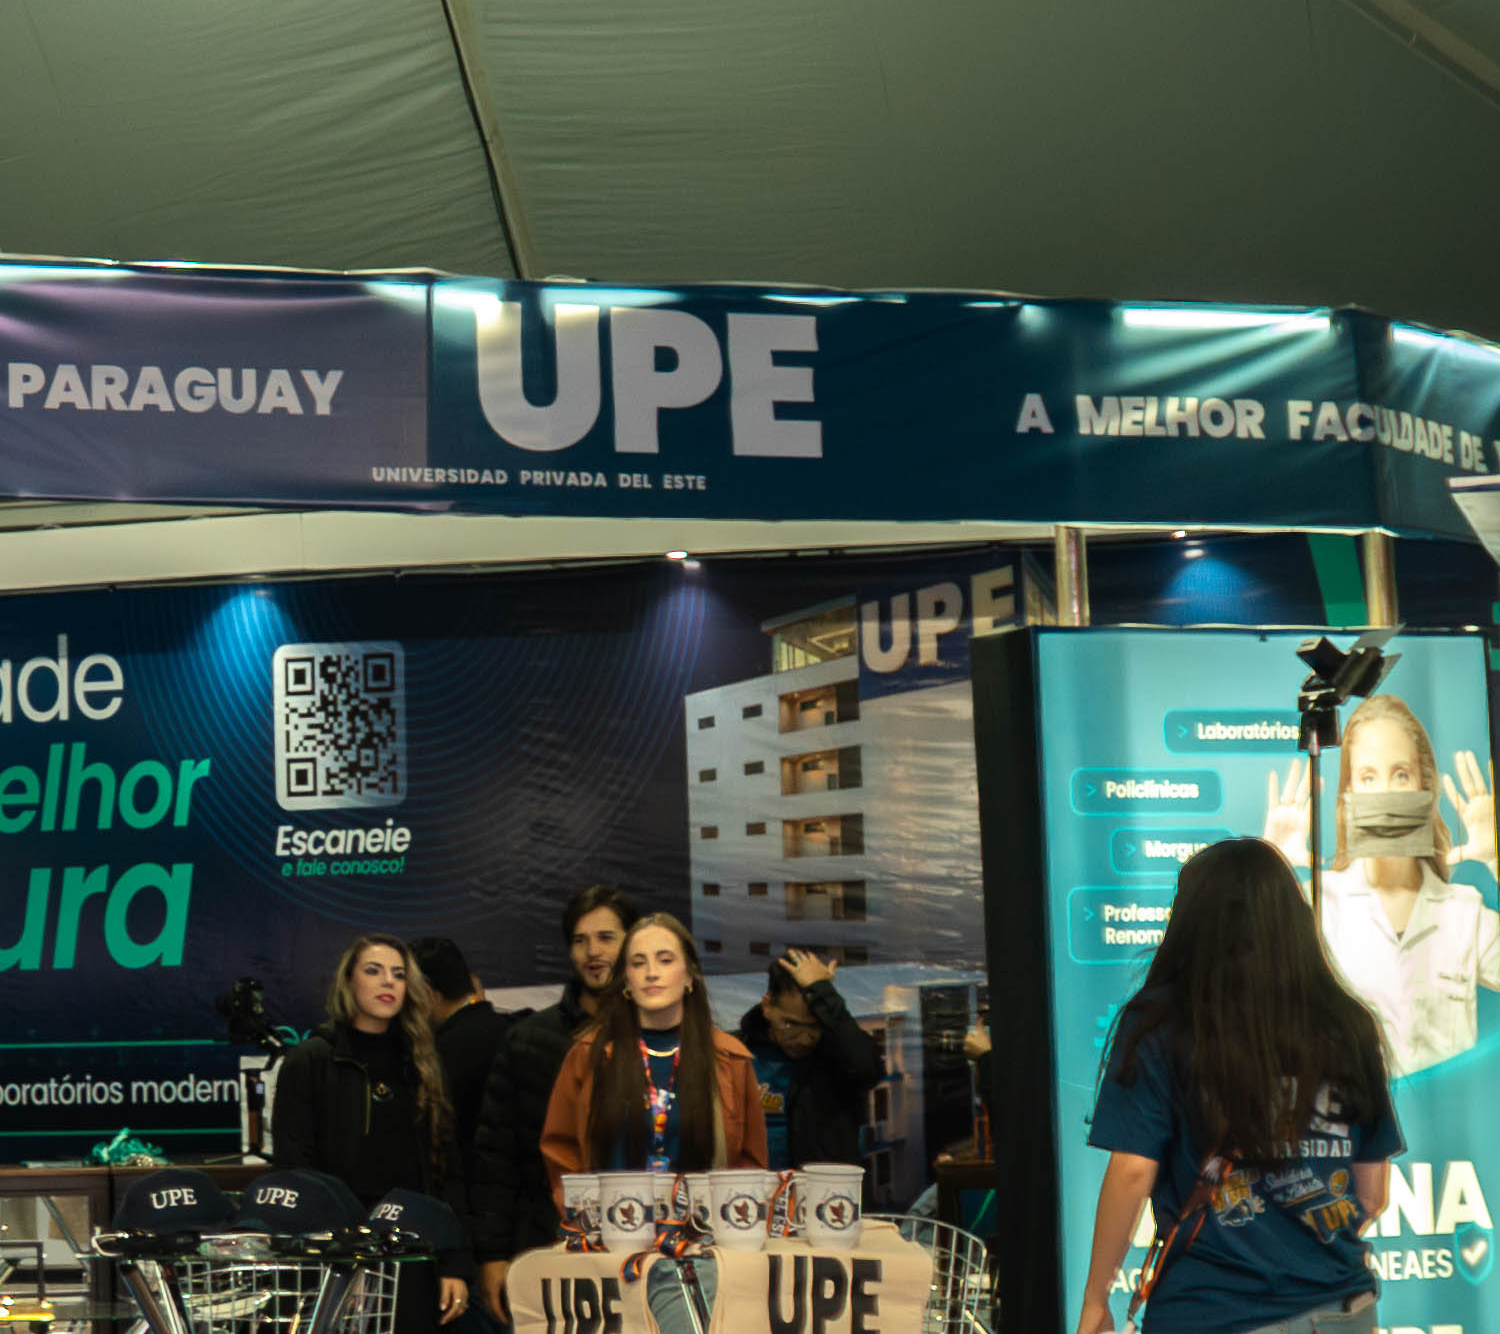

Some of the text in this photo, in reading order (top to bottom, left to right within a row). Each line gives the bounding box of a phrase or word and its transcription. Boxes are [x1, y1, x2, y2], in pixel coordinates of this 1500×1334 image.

[8, 363, 345, 417] PARAGUAY
[474, 297, 824, 460] UPE
[1015, 393, 1054, 435] A
[1075, 394, 1266, 440] MELHOR
[1288, 399, 1455, 465] FACULDADE
[1459, 430, 1488, 474] DE
[372, 467, 708, 491] UNIVERSIDAD PRIVADA DEL ESTE
[860, 564, 1016, 675] UPE
[1197, 720, 1301, 741] Laboratórios
[1104, 779, 1200, 799] Policlínicas
[274, 817, 412, 857] Escaneie
[280, 861, 293, 876] e
[296, 857, 328, 876] fale
[150, 1187, 198, 1210] UPE
[255, 1186, 300, 1209] UPE
[1366, 1248, 1454, 1281] NEAES
